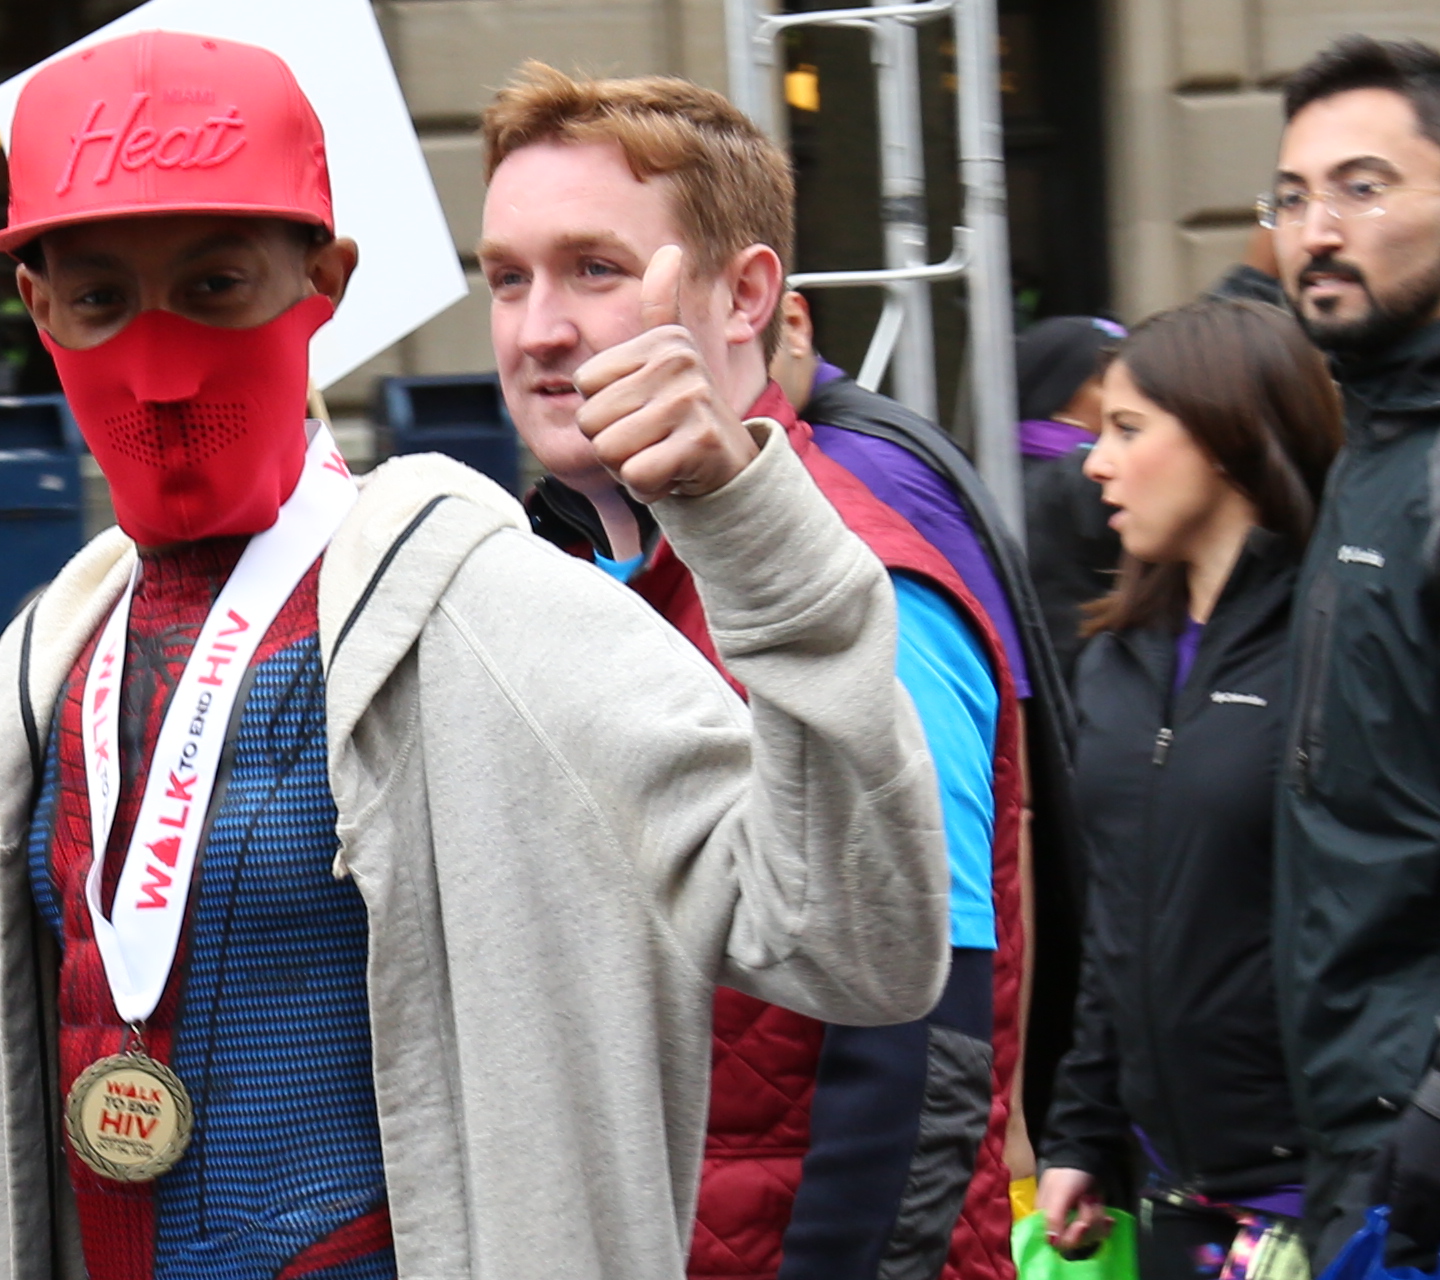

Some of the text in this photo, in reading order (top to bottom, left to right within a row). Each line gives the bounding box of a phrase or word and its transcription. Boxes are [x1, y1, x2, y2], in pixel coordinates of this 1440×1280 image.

[55, 91, 248, 198] Heat
[136, 609, 252, 912] WALK TO END HIV
[104, 1095, 161, 1116] TO END
[106, 1080, 163, 1105] WALK
[99, 1108, 159, 1140] HIV
